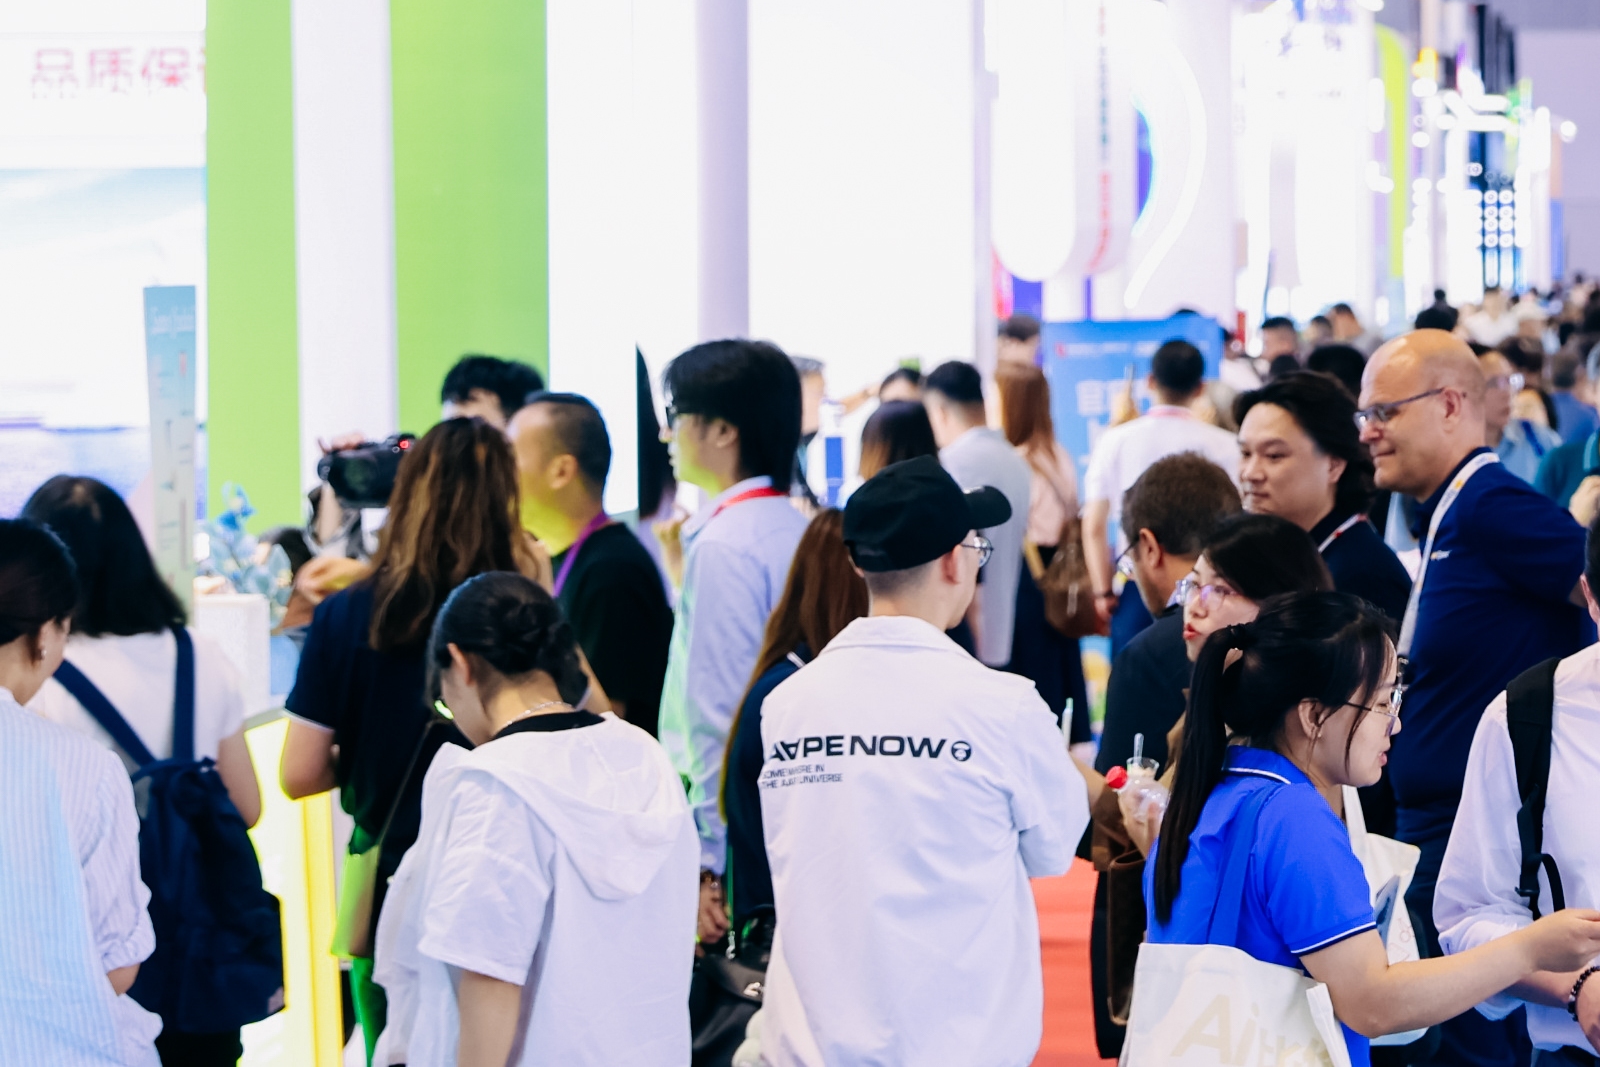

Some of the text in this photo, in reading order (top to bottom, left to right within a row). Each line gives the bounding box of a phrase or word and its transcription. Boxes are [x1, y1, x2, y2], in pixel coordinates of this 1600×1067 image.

[30, 46, 206, 99] 品质保
[849, 735, 947, 759] NOW
